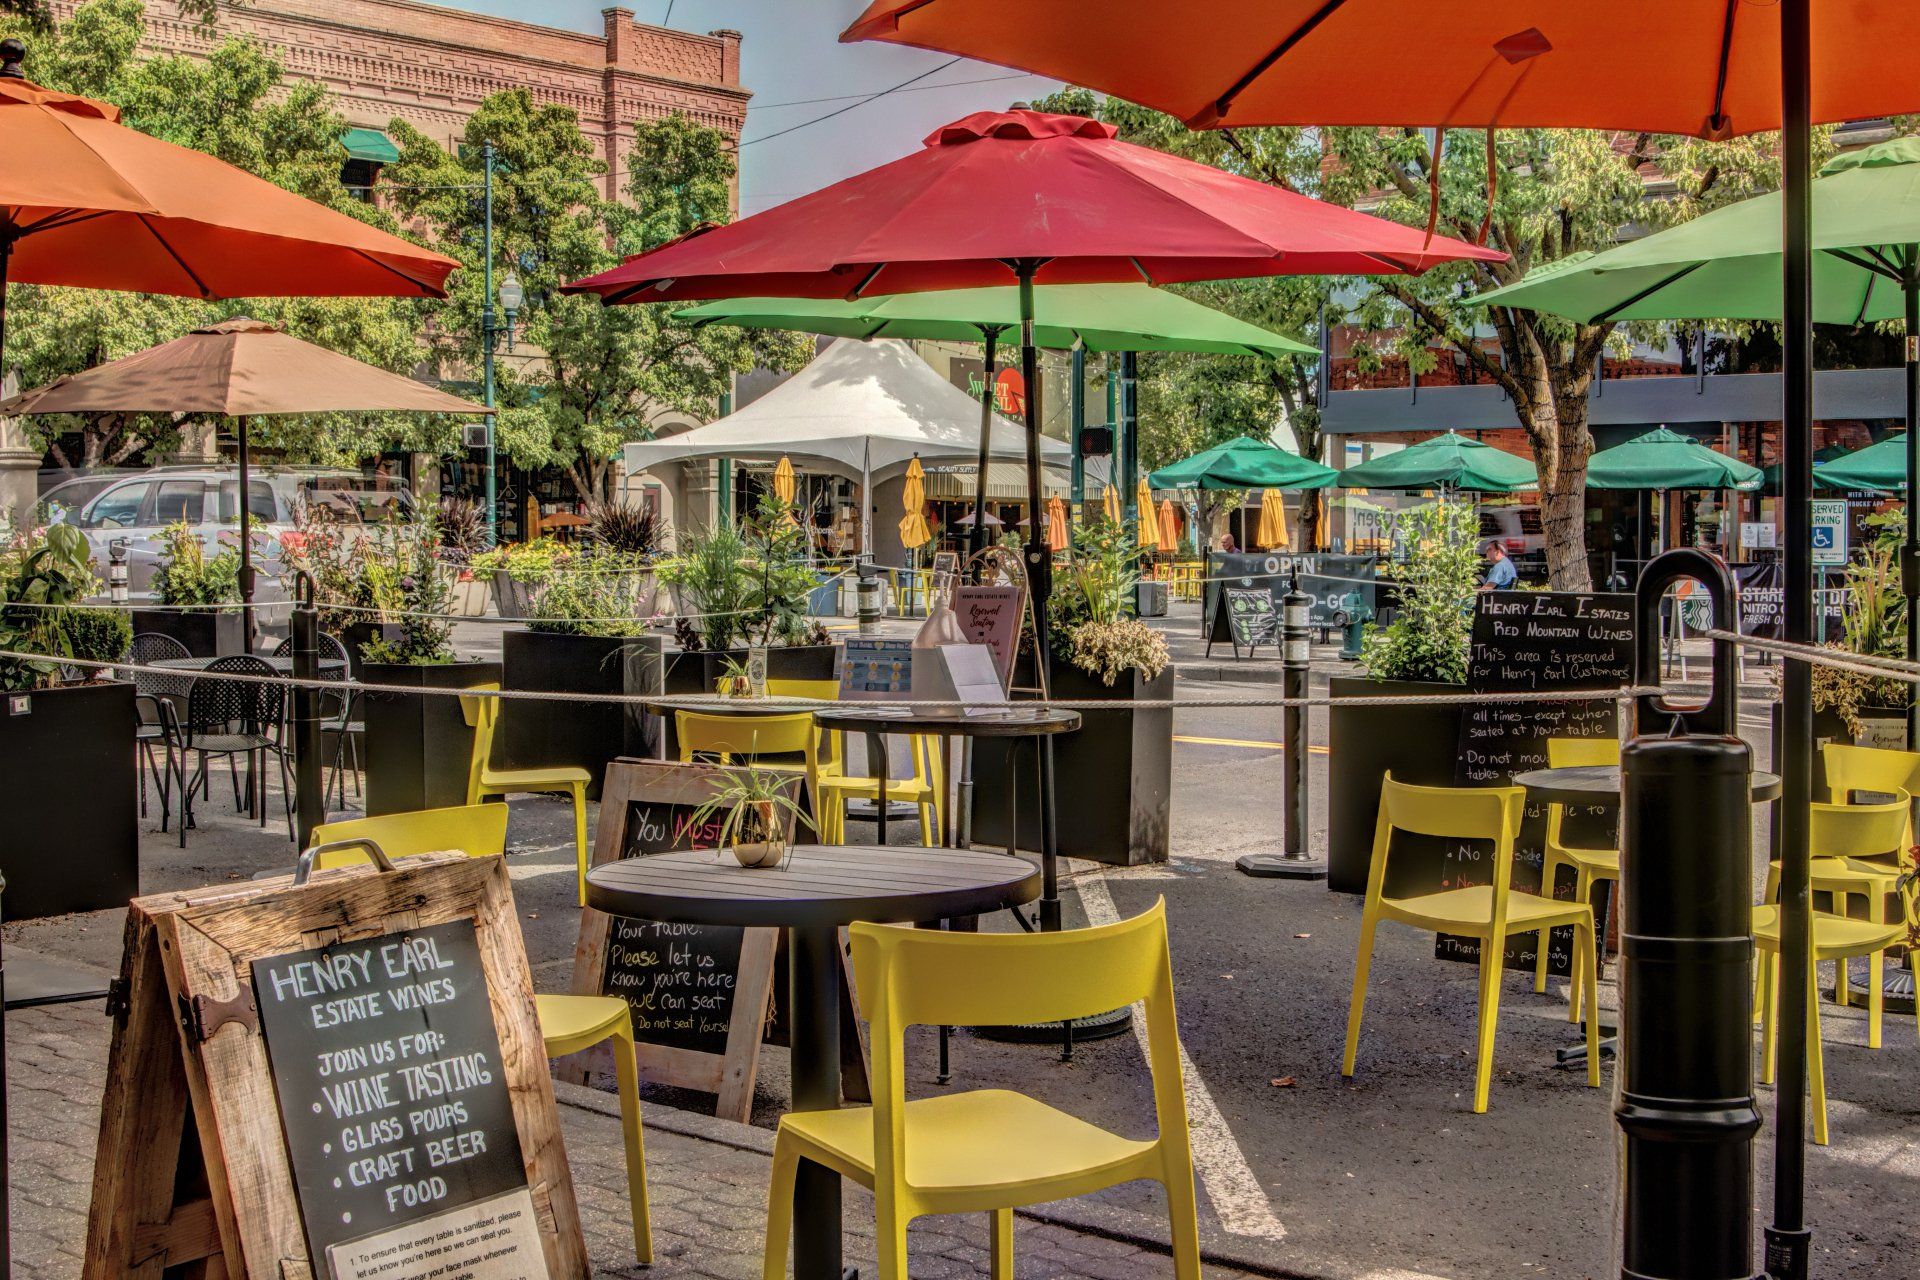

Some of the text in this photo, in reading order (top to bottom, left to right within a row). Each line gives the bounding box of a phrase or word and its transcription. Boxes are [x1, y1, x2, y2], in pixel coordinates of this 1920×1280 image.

[966, 372, 1009, 397] SWET
[1812, 505, 1843, 514] SERVED
[1814, 515, 1841, 525] RKING
[1265, 557, 1315, 574] OPEN
[1743, 603, 1777, 614] NITRO
[1743, 614, 1771, 625] FRESH
[1473, 643, 1615, 663] This area is reserved
[1502, 665, 1536, 689] Henry
[1543, 666, 1566, 680] Earl
[1570, 663, 1630, 680] Customers
[1473, 711, 1487, 722] all
[1534, 709, 1566, 725] except
[1572, 708, 1612, 721] when
[1470, 724, 1504, 738] seated
[1512, 724, 1527, 736] at
[1566, 721, 1606, 736] table
[1466, 750, 1486, 764] Do
[1489, 751, 1512, 764] not
[1466, 766, 1500, 780] tables
[635, 807, 666, 842] You
[1458, 845, 1480, 861] No
[618, 918, 646, 939] Your
[611, 941, 715, 967] Please let us
[270, 937, 454, 1001] HENRY EARL
[697, 970, 735, 989] here
[311, 977, 456, 1029] ESTATE WINES
[691, 990, 727, 1011] seat
[638, 1015, 651, 1029] Do
[654, 1016, 672, 1029] not
[673, 1014, 695, 1030] seat
[317, 1030, 446, 1077] JOIN US FOR:
[322, 1052, 492, 1119] WINE TASTING
[342, 1101, 469, 1153] GLASS POURS
[349, 1130, 487, 1187] CRAFT BEER
[385, 1176, 447, 1212] FOOD
[359, 1254, 369, 1264] To
[371, 1246, 397, 1260] ensure
[398, 1241, 413, 1252] that
[414, 1235, 435, 1248] every
[436, 1229, 454, 1241] table
[456, 1227, 462, 1235] is
[498, 1210, 521, 1224] please
[356, 1227, 513, 1279] let us know you're here so we can seat you.
[428, 1266, 444, 1279] your
[445, 1262, 462, 1273] face
[463, 1254, 482, 1268] mask
[483, 1244, 518, 1261] whenever
